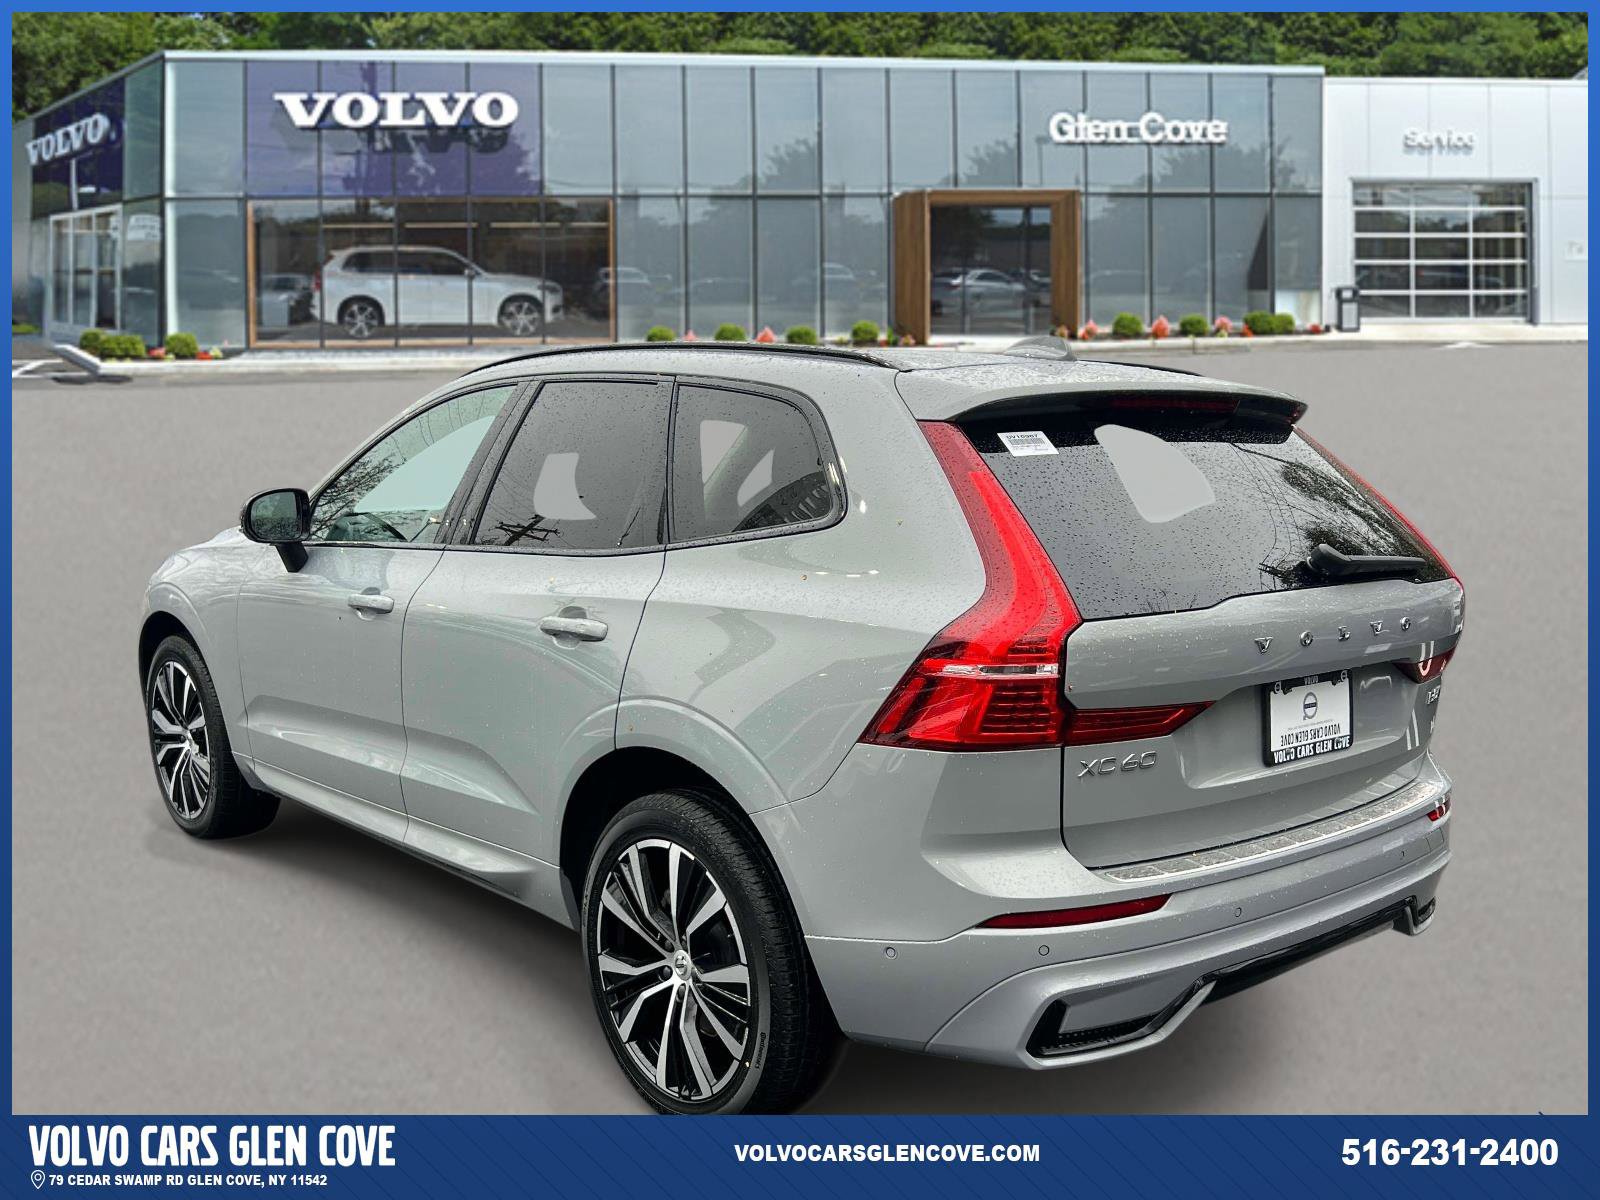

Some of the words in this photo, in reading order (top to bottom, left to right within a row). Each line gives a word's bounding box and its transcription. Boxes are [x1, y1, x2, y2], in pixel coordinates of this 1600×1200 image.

[272, 91, 519, 128] VOLVO
[25, 112, 110, 166] VOLVO
[1049, 111, 1131, 143] Glen
[1139, 111, 1229, 143] Cove
[1254, 616, 1411, 655] VOLVO
[1281, 733, 1294, 747] COVE
[1296, 730, 1309, 743] GLEN
[1310, 726, 1323, 741] CARS
[1296, 743, 1314, 759] CARS
[1315, 739, 1333, 754] GLEN
